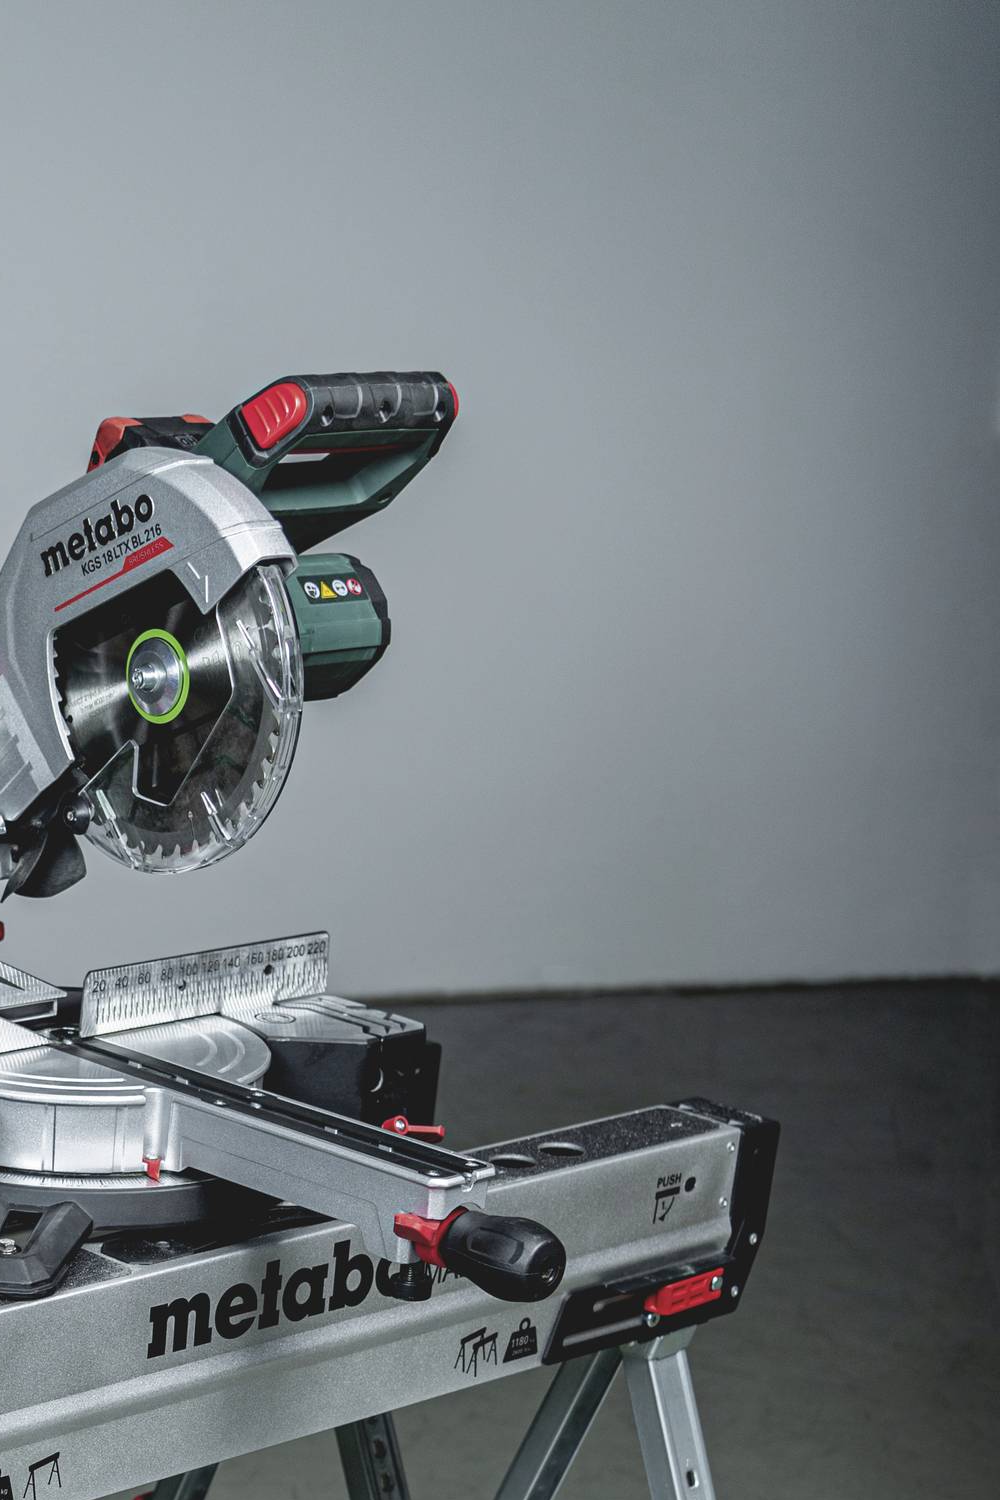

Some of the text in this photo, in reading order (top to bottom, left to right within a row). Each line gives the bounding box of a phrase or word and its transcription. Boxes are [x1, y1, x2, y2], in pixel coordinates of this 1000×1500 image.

[40, 494, 154, 577] metabo
[81, 523, 162, 577] KGS 18 LTX BL 216
[92, 940, 327, 993] 20 40 60 80 100 120 140 160 180 200 220
[656, 1172, 682, 1189] PUSH
[511, 1335, 529, 1348] 1180
